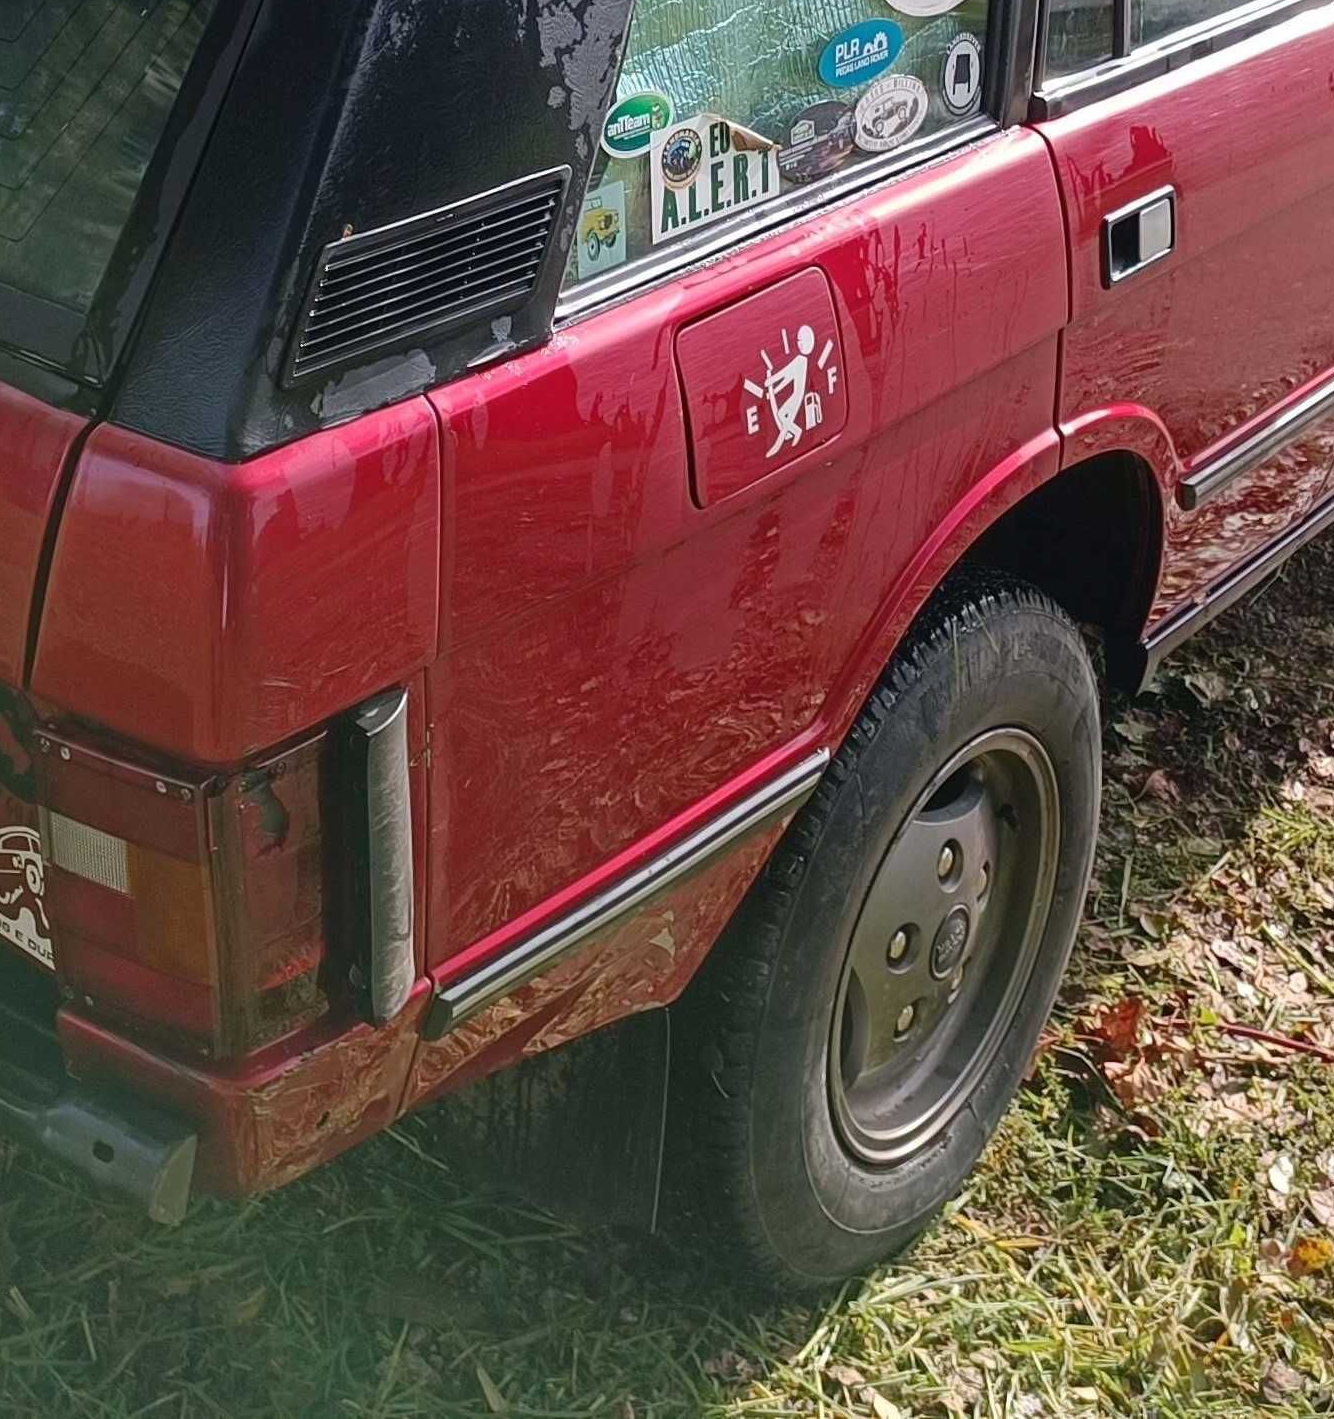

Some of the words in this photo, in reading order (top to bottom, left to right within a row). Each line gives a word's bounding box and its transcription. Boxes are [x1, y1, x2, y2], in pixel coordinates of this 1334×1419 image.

[835, 37, 860, 64] PLR
[854, 57, 870, 73] LAND
[870, 50, 889, 68] ROVER
[827, 366, 838, 395] F
[746, 406, 759, 435] E
